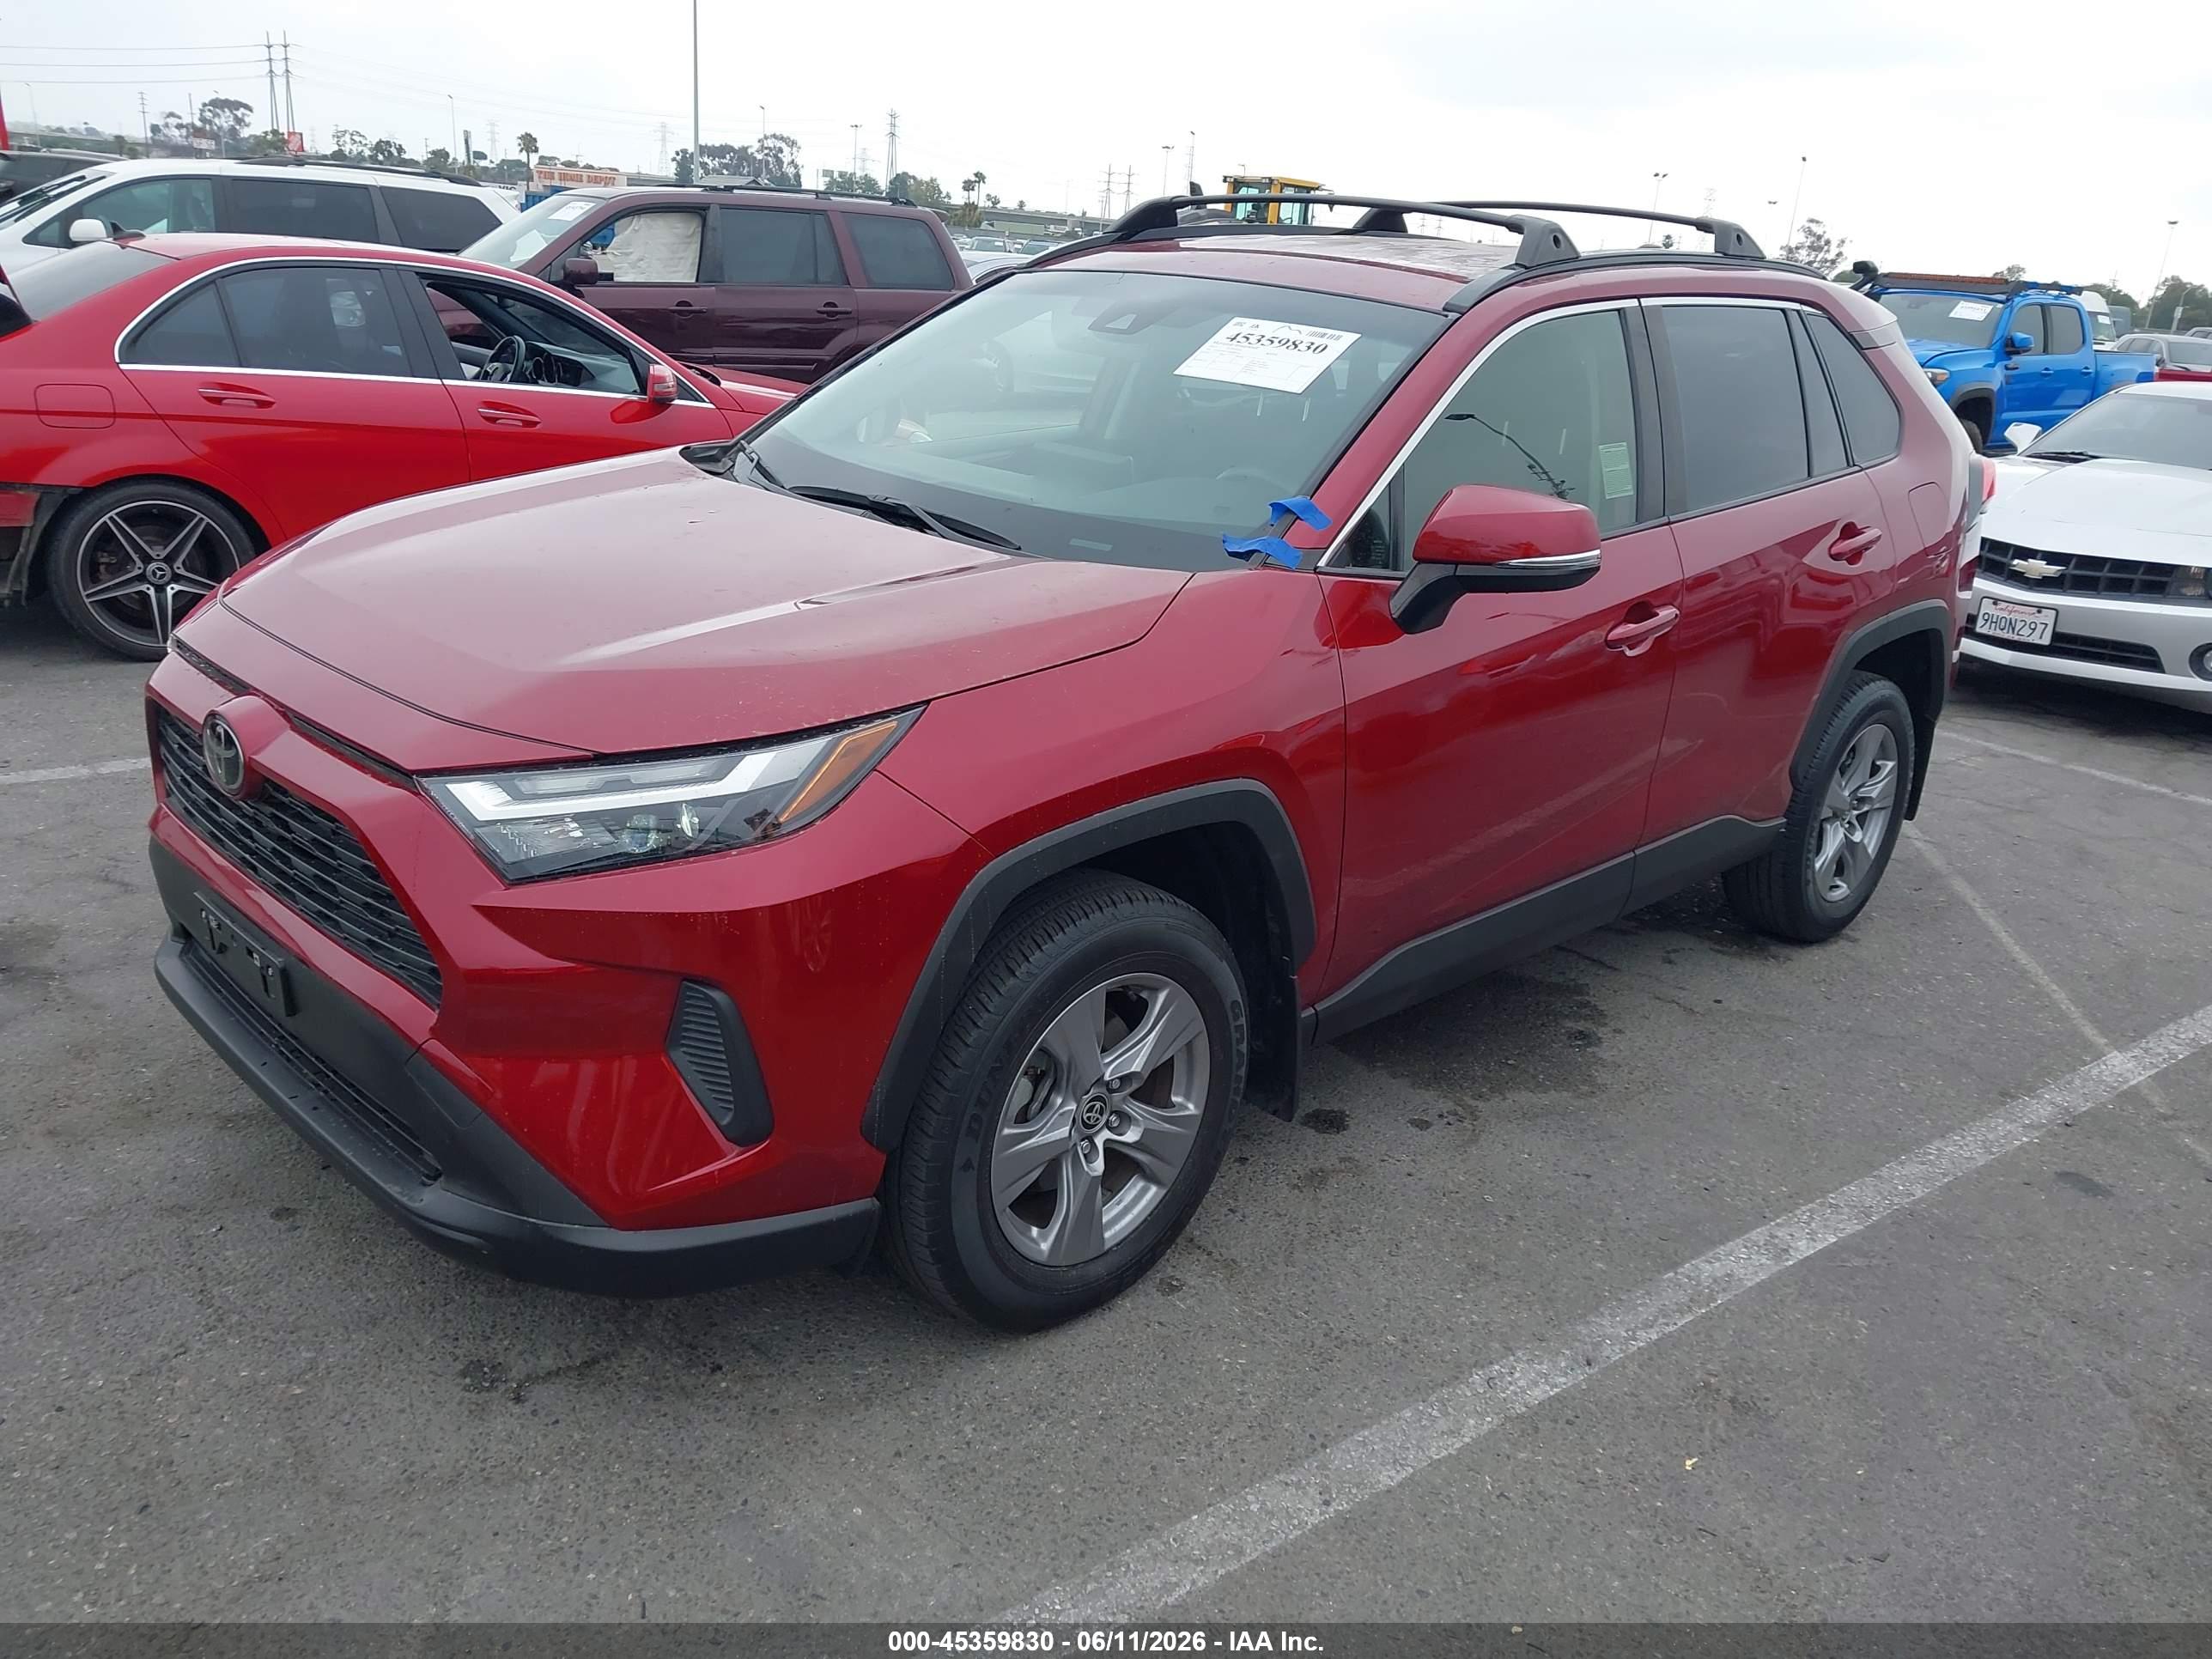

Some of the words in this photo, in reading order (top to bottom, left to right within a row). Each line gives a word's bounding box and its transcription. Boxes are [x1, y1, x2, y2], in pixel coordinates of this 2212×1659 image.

[559, 172, 584, 182] HOME
[587, 174, 616, 185] DEPOT
[1226, 331, 1328, 355] 45359830
